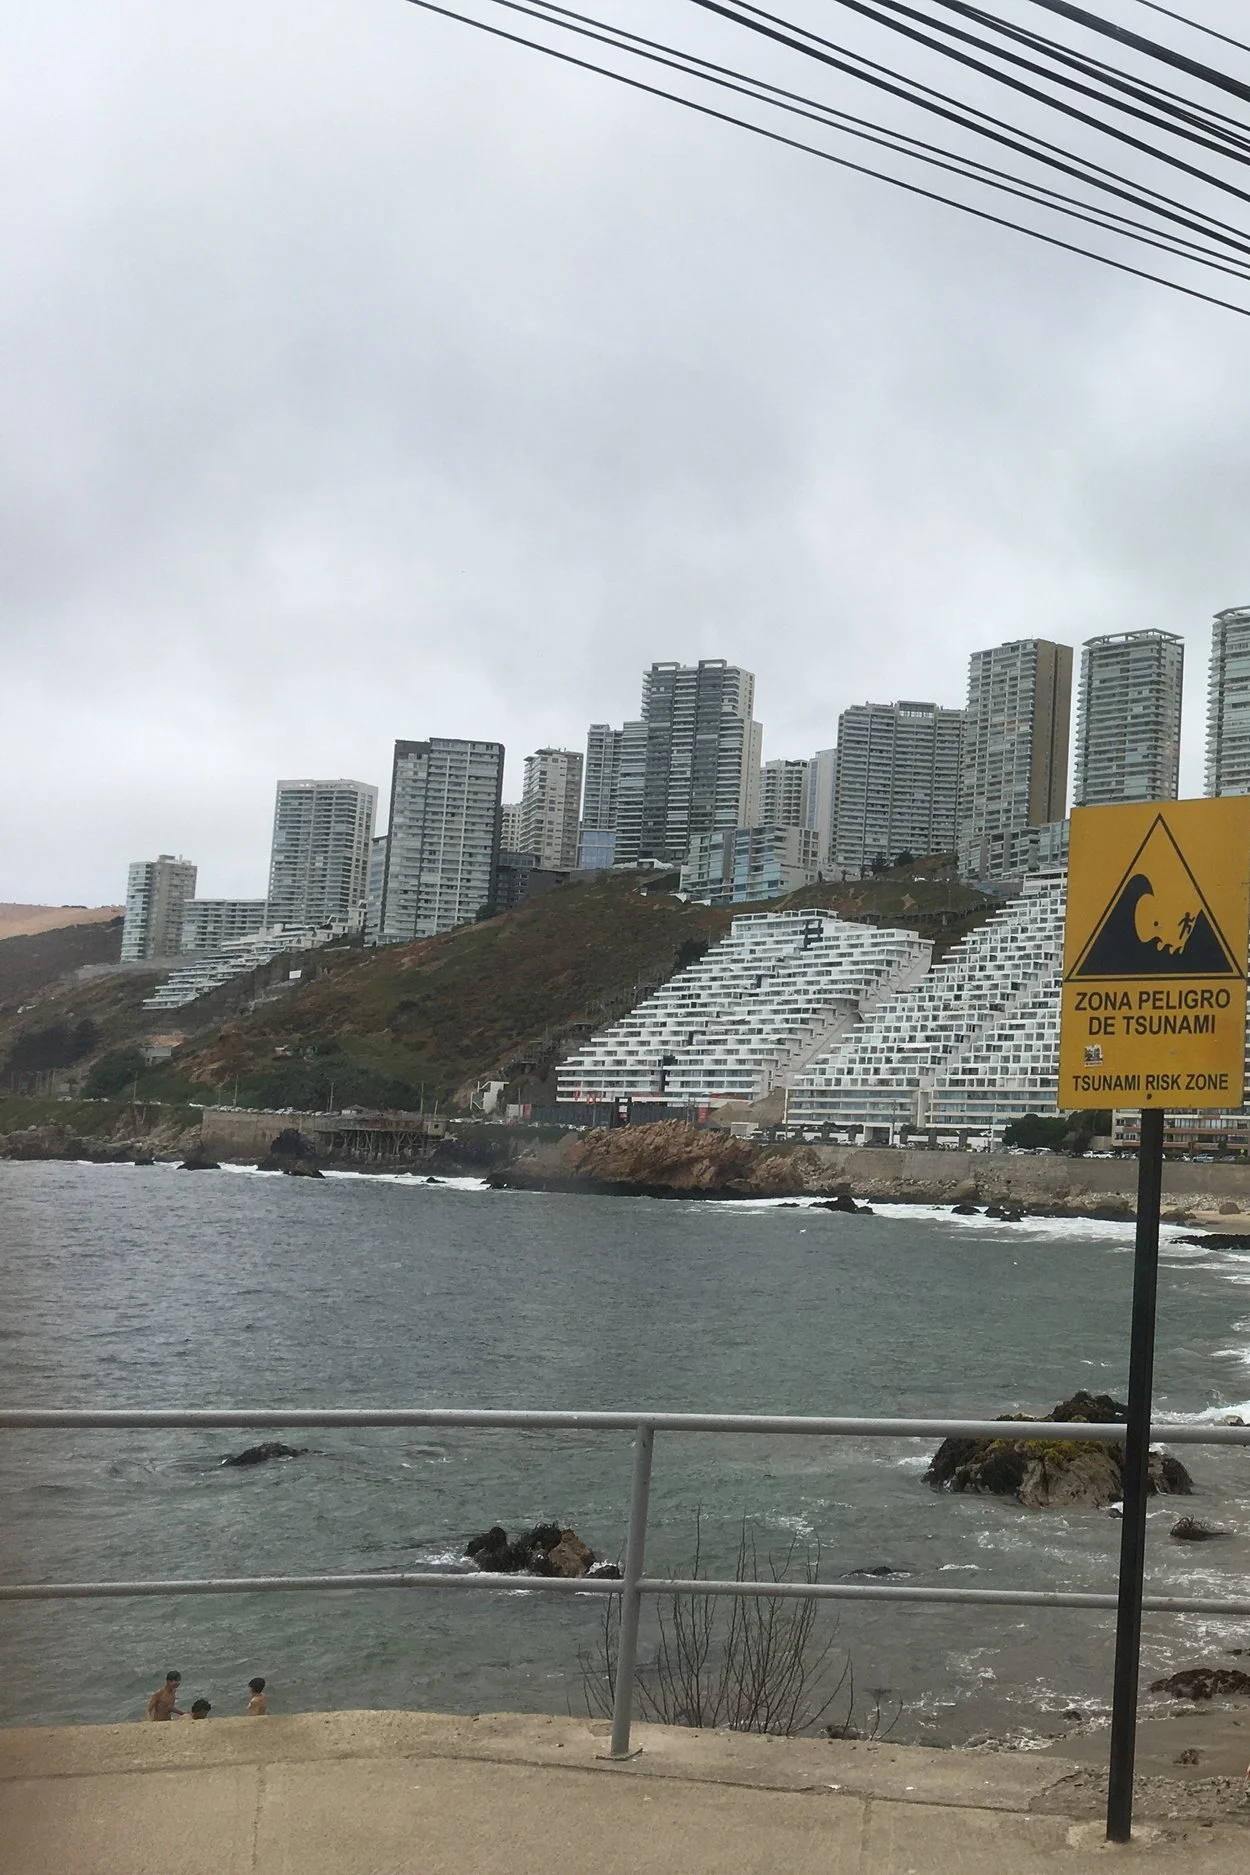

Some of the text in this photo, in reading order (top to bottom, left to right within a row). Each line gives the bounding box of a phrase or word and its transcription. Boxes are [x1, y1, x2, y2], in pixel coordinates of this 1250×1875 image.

[1075, 988, 1231, 1011] ZONA PELIGRO
[1089, 1014, 1216, 1035] DE TSUNAMI
[1073, 1073, 1229, 1091] TSUNAMI RISK ZONE
